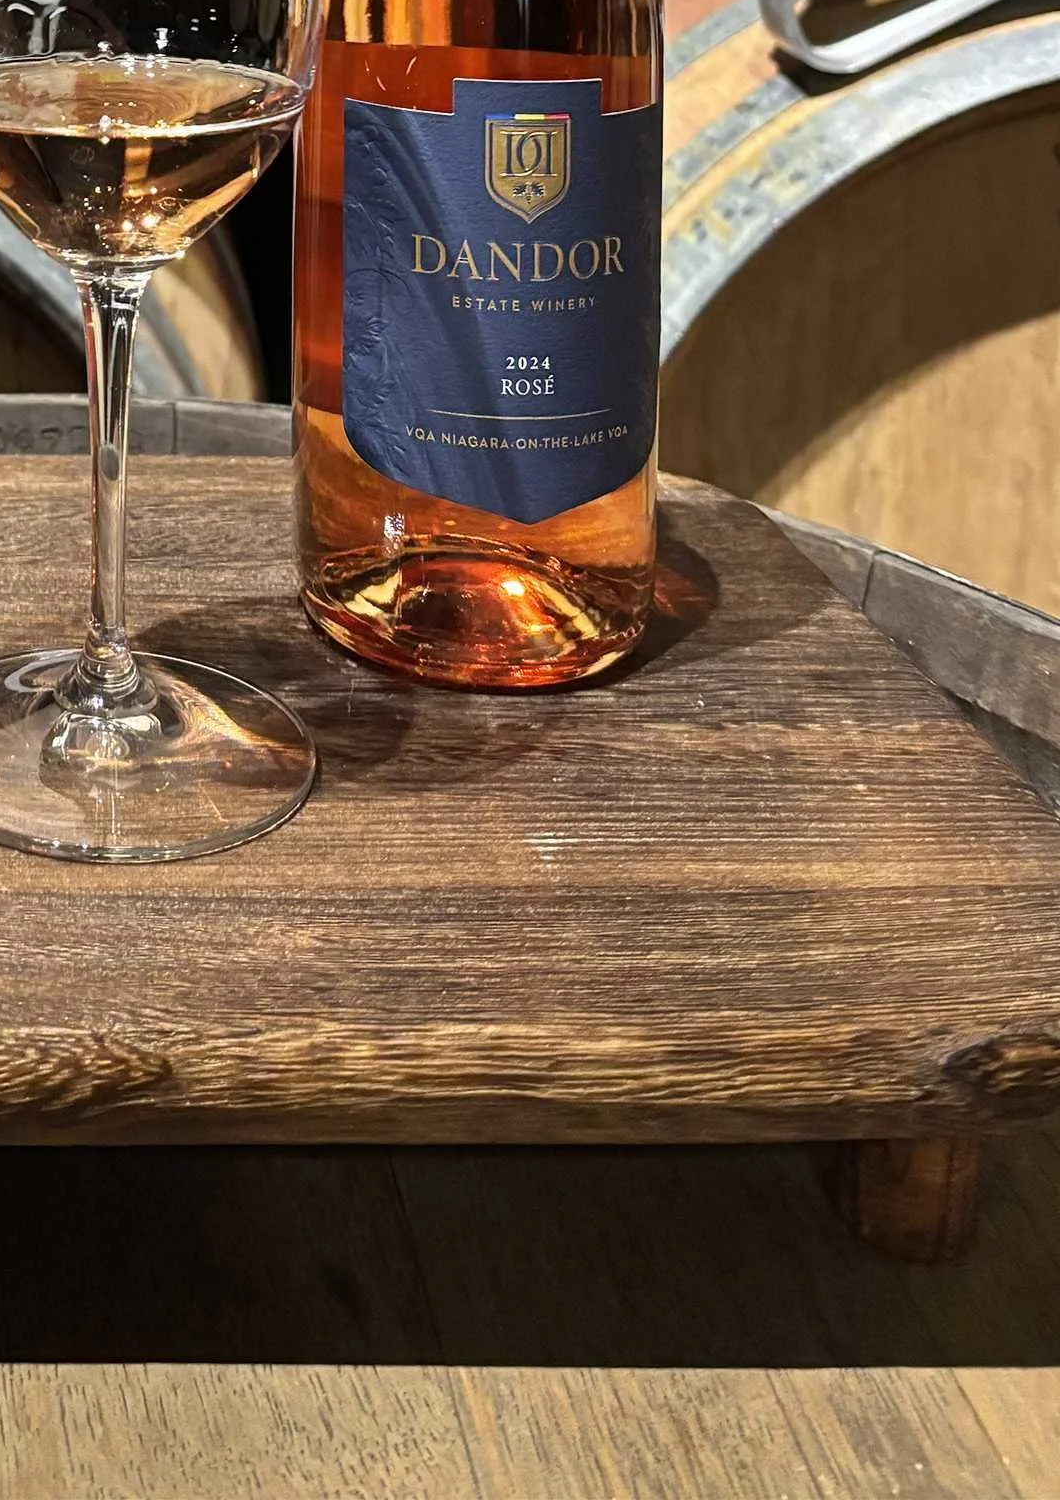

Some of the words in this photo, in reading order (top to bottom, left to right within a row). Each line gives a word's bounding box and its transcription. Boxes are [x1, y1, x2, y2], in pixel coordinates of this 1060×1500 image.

[411, 233, 625, 283] DANDOR
[451, 295, 521, 312] ESTATE
[531, 295, 596, 312] WINERY
[506, 356, 551, 370] 2024
[500, 375, 556, 396] ROSÉ
[404, 424, 436, 442] VQA
[608, 424, 629, 439] VQA
